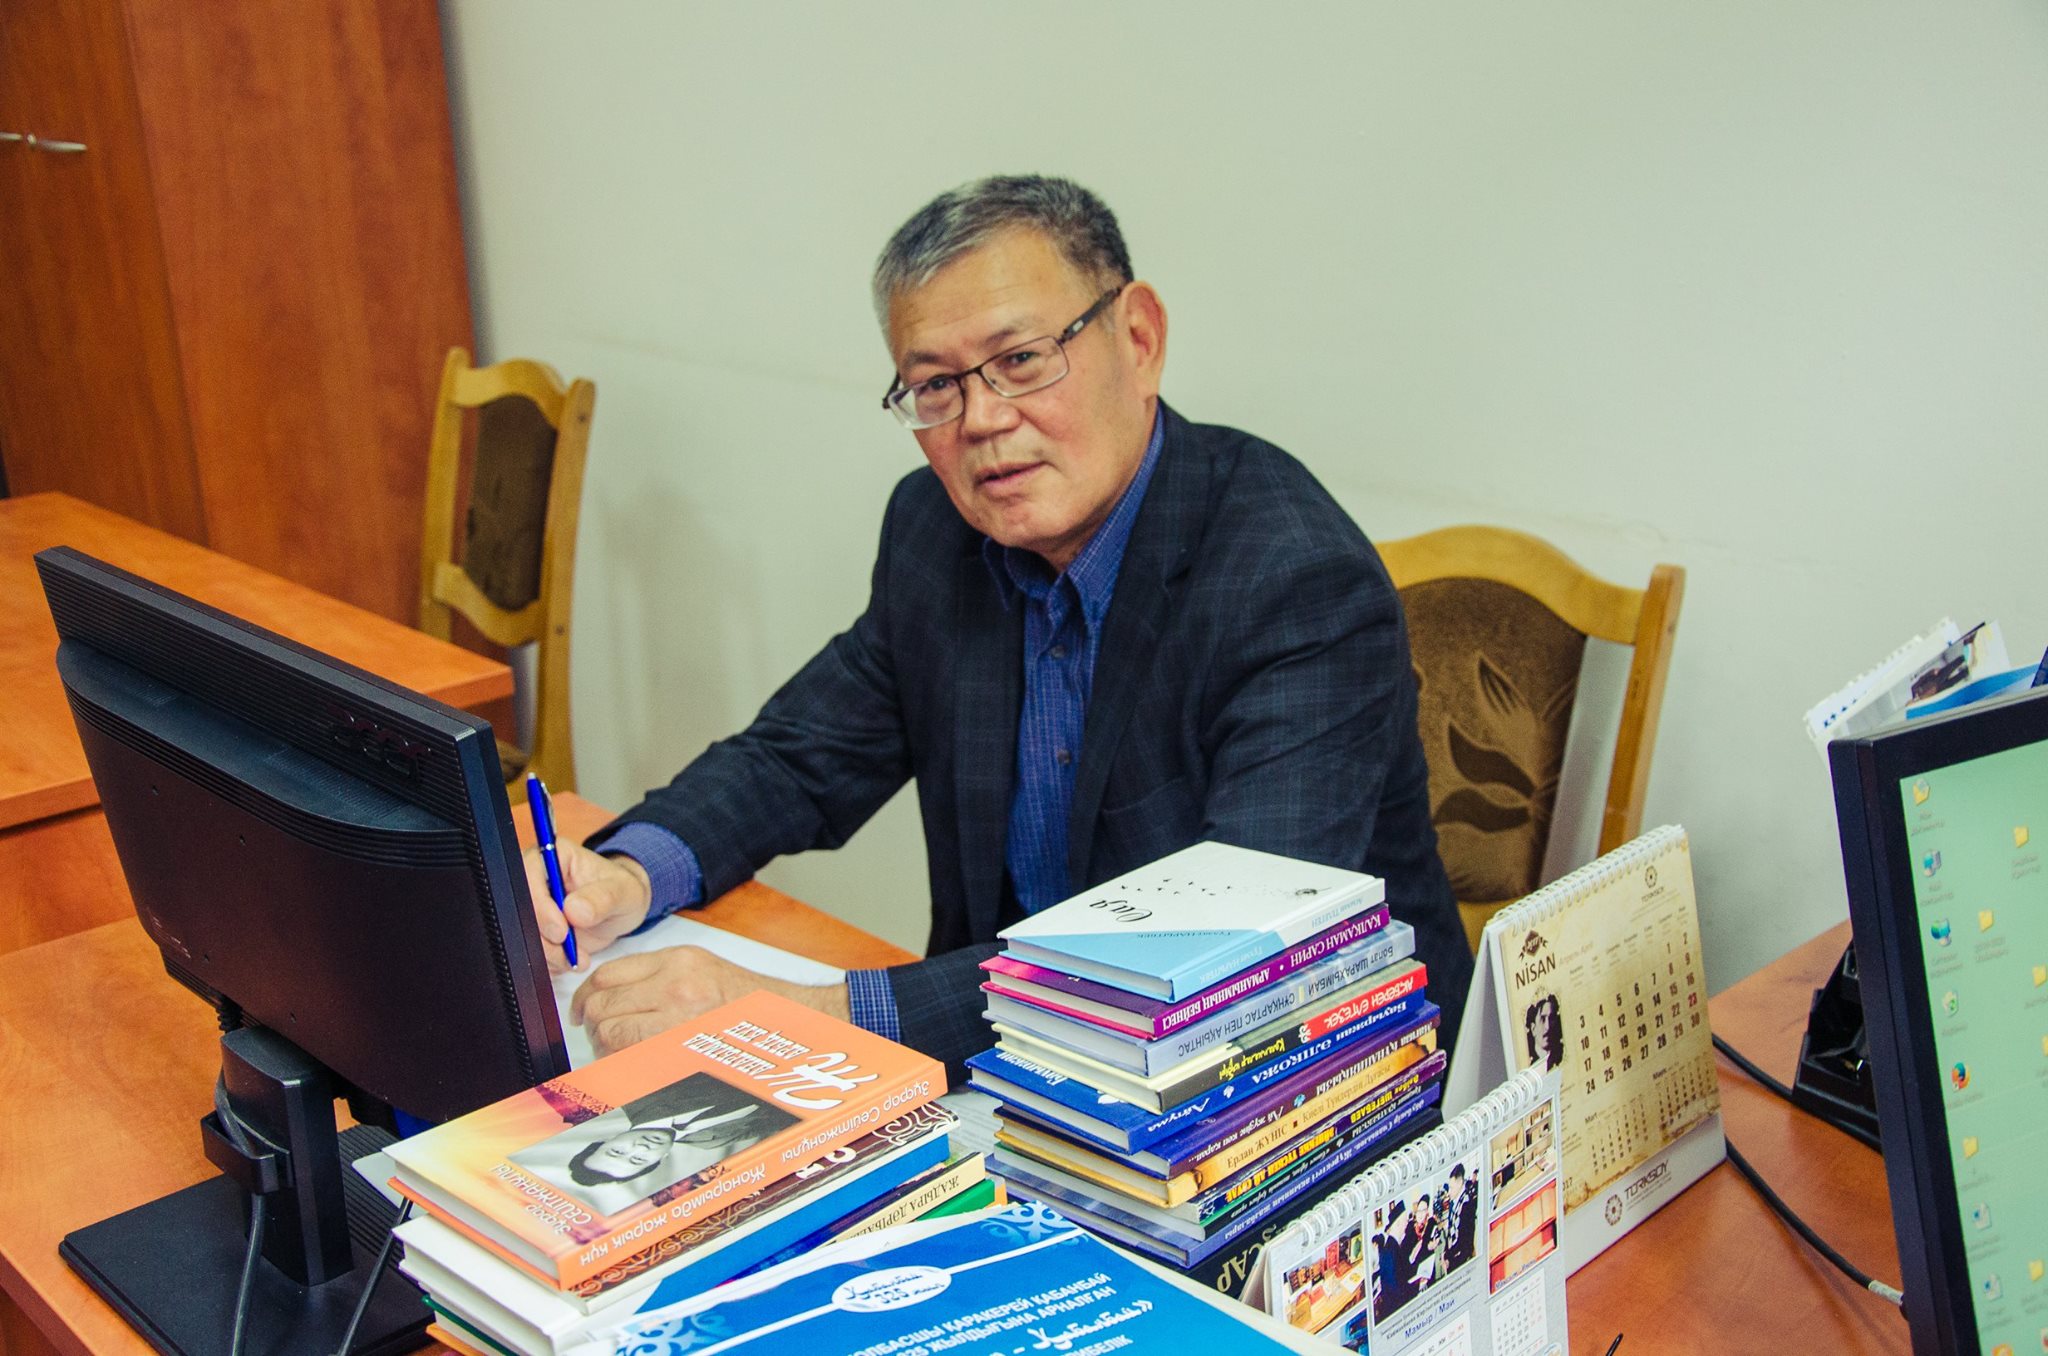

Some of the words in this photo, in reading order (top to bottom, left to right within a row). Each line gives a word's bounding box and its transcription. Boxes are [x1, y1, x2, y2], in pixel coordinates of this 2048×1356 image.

[1323, 913, 1382, 948] ҚАЛҚАМАН
[1667, 942, 1672, 954] 1
[1287, 939, 1326, 966] САРИН
[1368, 945, 1395, 963] Болат
[1200, 967, 1272, 1010] АРМАНЫМНЫҢ
[1306, 957, 1370, 994] ШАРАХЫМБАЙ
[1370, 976, 1416, 1005] АҚБЕРЕН
[1160, 1001, 1203, 1030] БЕЙНЕСІ
[1243, 991, 1296, 1024] СҰҢҚАРТАС
[1322, 997, 1370, 1029] ЕЛГЕЗЕК
[1579, 1015, 1586, 1029] 3
[1598, 1004, 1604, 1016] 4
[1616, 993, 1622, 1006] 5
[1634, 982, 1640, 996] 6
[1652, 972, 1657, 985] 7
[1581, 1036, 1589, 1050] 10
[1600, 1025, 1608, 1039] 11
[1618, 1013, 1626, 1029] 12
[1635, 1003, 1644, 1018] 13
[1652, 992, 1661, 1007] 14
[1669, 982, 1678, 996] 15
[1686, 972, 1695, 986] 16
[1219, 1016, 1245, 1036] ПЕН
[1335, 1000, 1407, 1041] Бауыржан
[1584, 1057, 1592, 1072] 17
[1602, 1046, 1611, 1061] 18
[1620, 1034, 1629, 1050] 19
[1637, 1023, 1647, 1040] 20
[1655, 1013, 1664, 1028] 21
[1671, 1002, 1680, 1018] 22
[1175, 1025, 1224, 1057] АҚЫНТАС
[1250, 1037, 1332, 1084] ӘЛІҚОЖА
[1586, 1078, 1596, 1094] 24
[1604, 1066, 1614, 1083] 25
[1622, 1055, 1632, 1072] 26
[1640, 1044, 1649, 1060] 27
[1657, 1033, 1667, 1049] 28
[879, 1077, 932, 1115] Зұфар
[1350, 1091, 1393, 1123] ШЕГЕБАЕВ
[779, 1104, 881, 1164] Сейітжанұлы
[1224, 1145, 1255, 1169] Ерлан
[668, 1162, 768, 1221] Жанарымда
[908, 1175, 961, 1211] ЖАДЫРА
[525, 1203, 571, 1234] Зұфар
[608, 1208, 669, 1251] жарық
[577, 1239, 610, 1267] күн
[925, 1313, 1040, 1354] ЖЫЛДЫҒЫНА
[1037, 1286, 1117, 1319] АРНАЛҒАН
[942, 1297, 1034, 1333] ҚАРАКЕРЕЙ
[1030, 1272, 1112, 1305] ҚАБАНБАЙ
